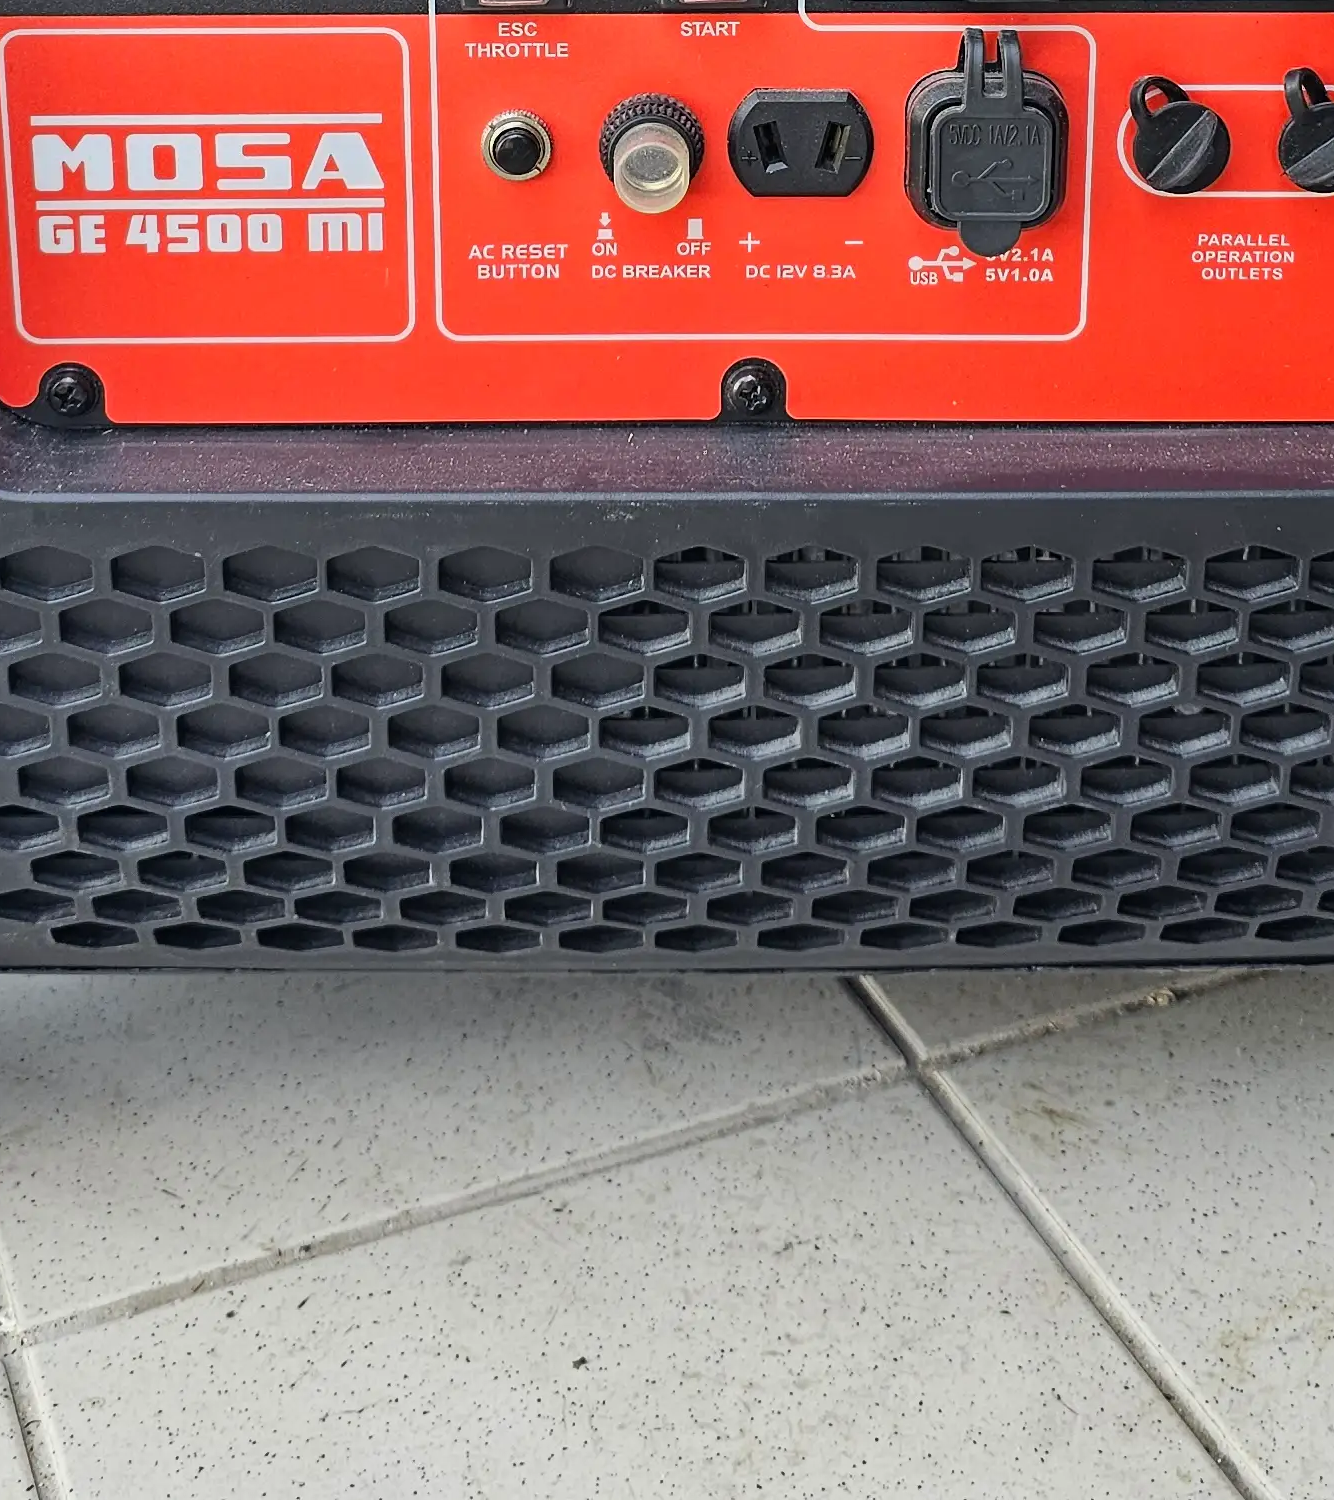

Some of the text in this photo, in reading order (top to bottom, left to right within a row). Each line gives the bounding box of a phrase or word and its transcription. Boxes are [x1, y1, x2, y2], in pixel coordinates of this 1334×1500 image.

[498, 22, 537, 37] ESC
[680, 21, 740, 37] START
[465, 43, 569, 58] THROTTLE
[31, 132, 384, 192] MOSA
[39, 212, 384, 254] GE 4500 MI
[1198, 234, 1290, 246] PARALLEL
[468, 244, 569, 260] AC RESET
[592, 242, 618, 256] ON
[677, 242, 712, 256] OFF
[985, 247, 1055, 262] V2.1A
[1191, 251, 1295, 263] OPERATION
[477, 264, 560, 279] BUTTON
[591, 265, 712, 279] DC BREAKER
[746, 265, 856, 279] DC 12V 8.3A
[910, 271, 939, 285] USB
[985, 268, 1055, 282] 5V1.0A
[1201, 267, 1283, 280] OUTLETS
